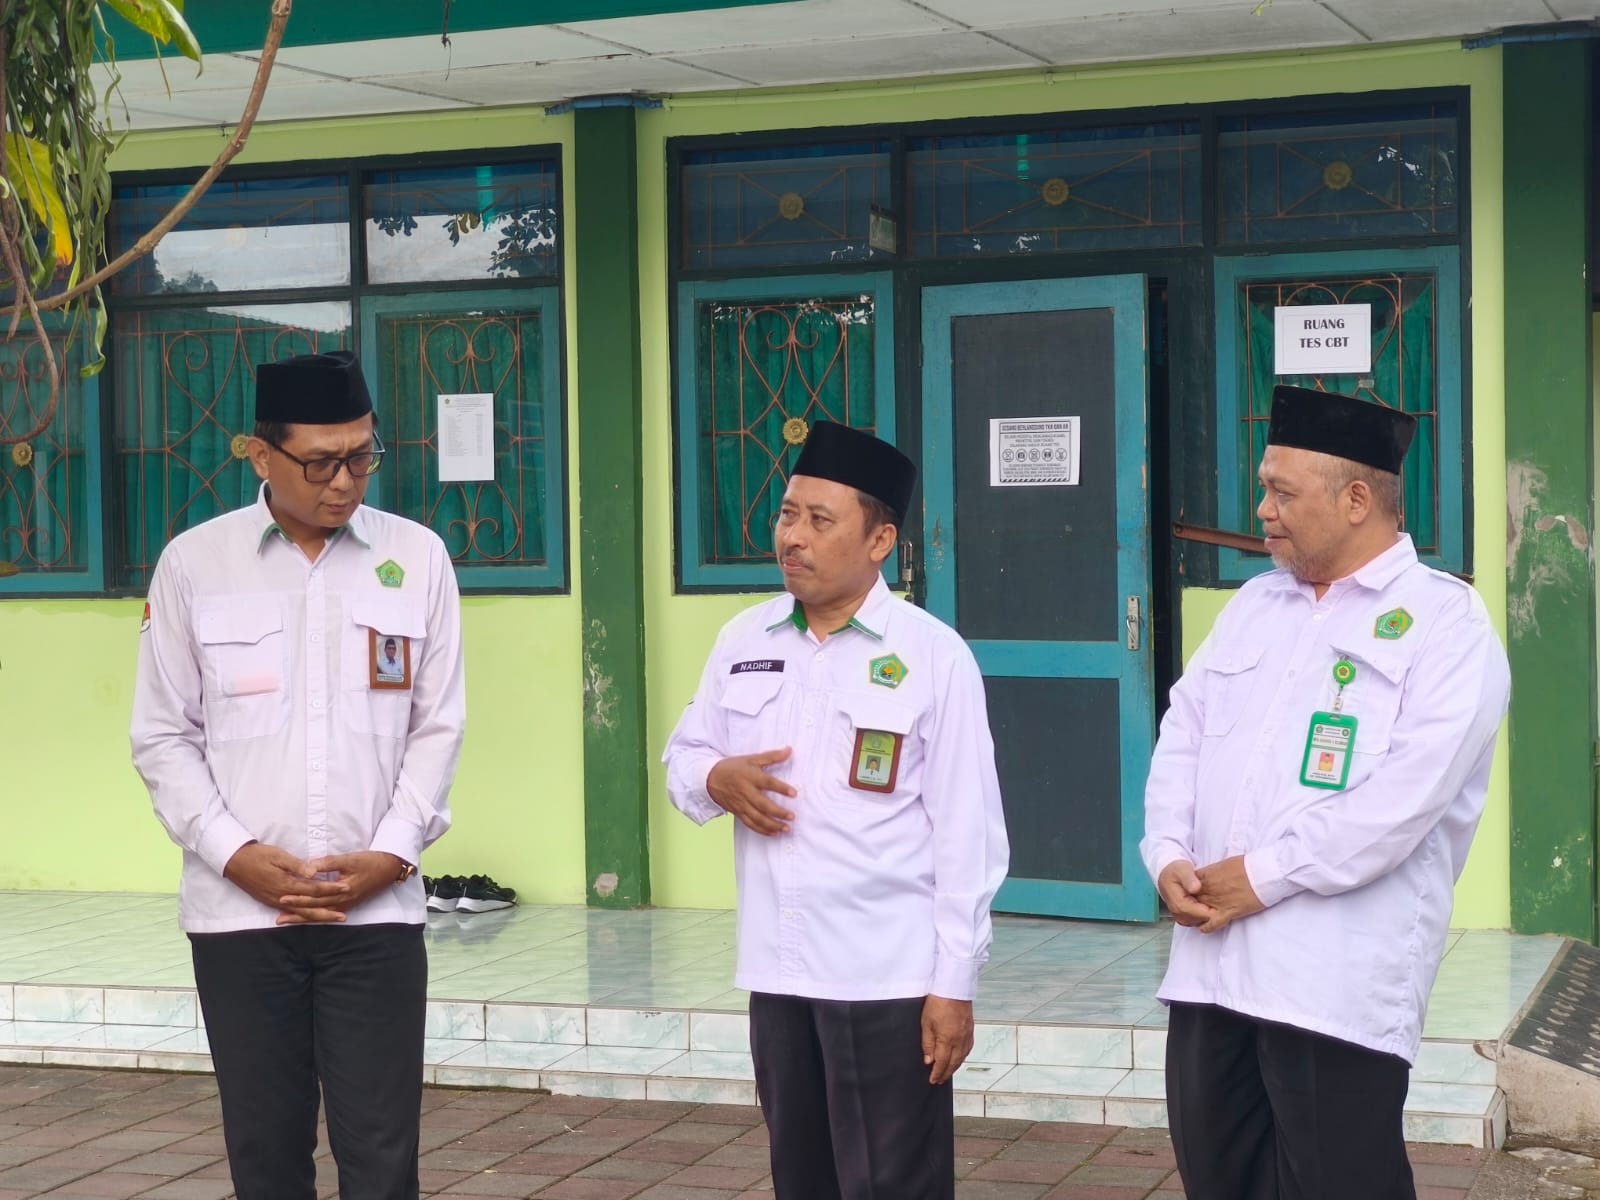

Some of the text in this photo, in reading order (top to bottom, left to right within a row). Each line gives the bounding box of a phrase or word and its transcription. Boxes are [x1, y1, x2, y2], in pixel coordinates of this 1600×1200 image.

[1304, 319, 1345, 330] RUANG
[1299, 336, 1349, 348] TES CBT
[740, 661, 772, 671] NADHIF
